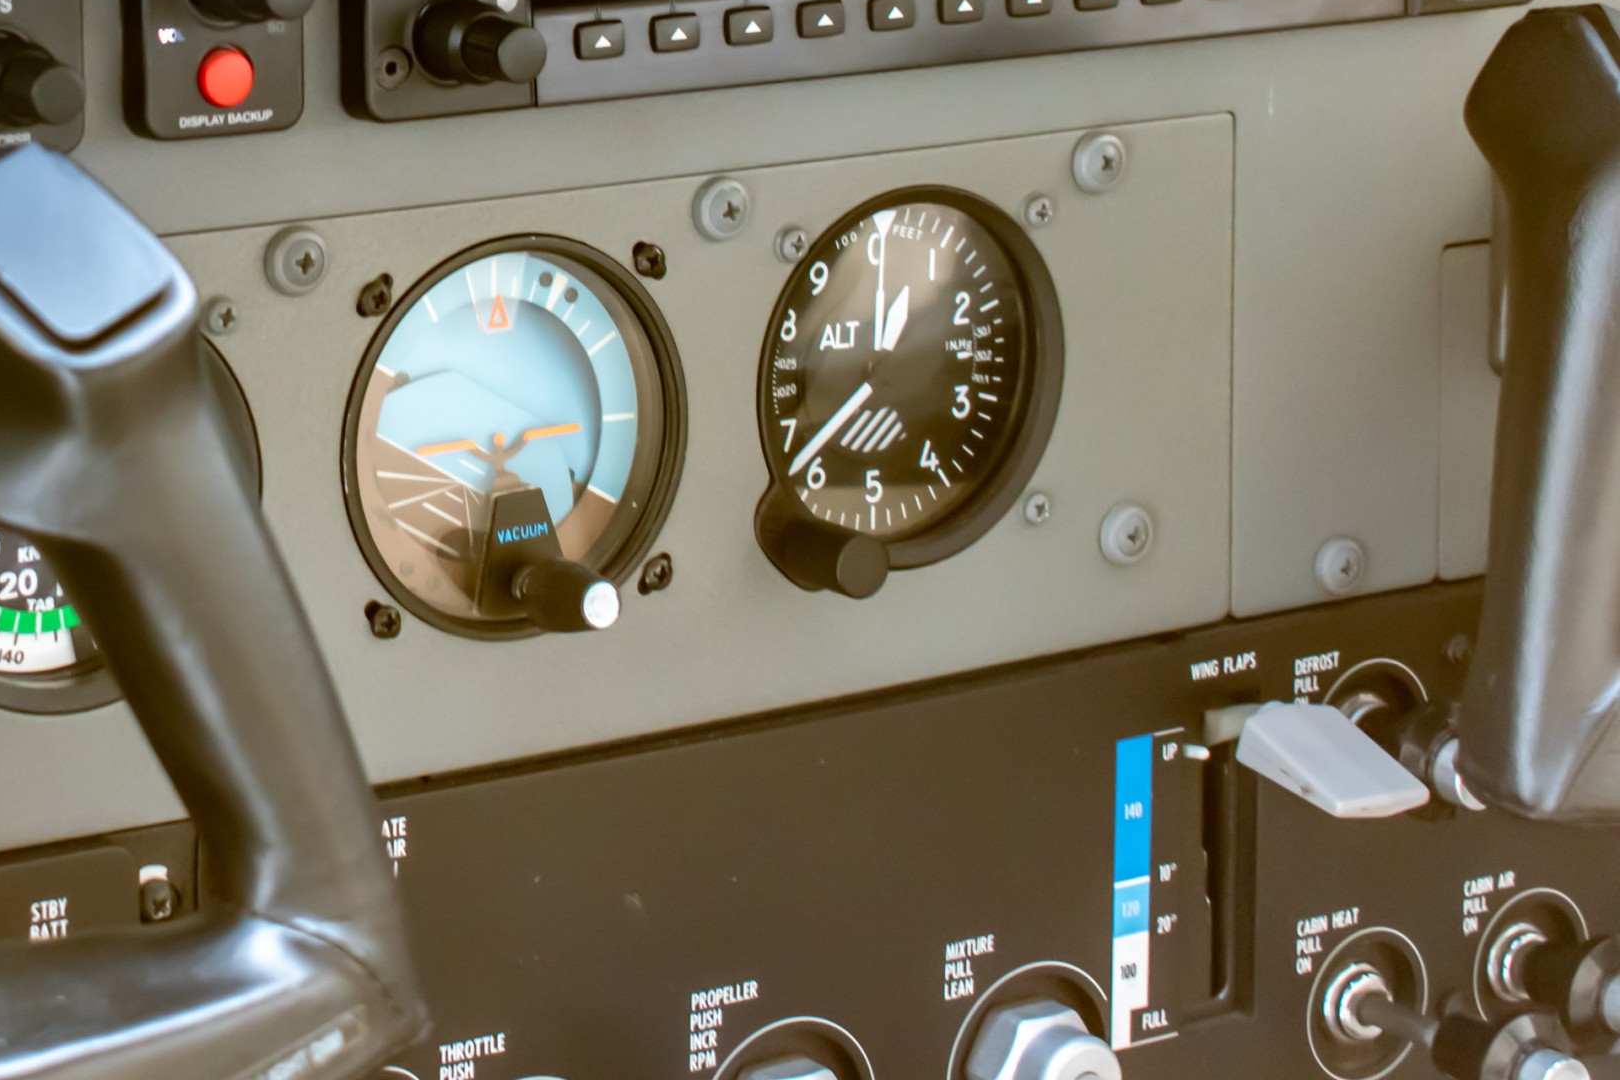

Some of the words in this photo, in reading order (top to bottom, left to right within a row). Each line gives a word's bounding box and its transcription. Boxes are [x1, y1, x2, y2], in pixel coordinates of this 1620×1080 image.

[179, 113, 225, 129] DISPLAY
[227, 109, 273, 125] BACKUP
[953, 291, 970, 325] 2
[819, 320, 860, 350] ALT
[951, 384, 970, 419] 3
[780, 418, 797, 453] 7
[919, 439, 940, 472] 4
[864, 469, 883, 503] 5
[496, 521, 548, 545] VACUUM
[1190, 659, 1220, 681] WING
[1223, 651, 1257, 674] FLAPS
[1294, 651, 1340, 676] DEFROST
[1294, 674, 1320, 695] PULL
[1463, 877, 1493, 899] CABIN
[1497, 871, 1515, 891] AIR
[30, 897, 68, 922] STBY
[1296, 914, 1329, 938] CABIN
[1332, 907, 1360, 930] HEAT
[945, 933, 995, 961] MIXTURE
[1296, 935, 1321, 957] PULL
[944, 958, 973, 981] PULL
[691, 980, 759, 1011] PROPELLER
[944, 978, 974, 1001] LEAN
[690, 1008, 723, 1032] PUSH
[1141, 1010, 1169, 1030] FULL
[440, 1033, 506, 1064] THROTTLE
[690, 1029, 717, 1052] INCR
